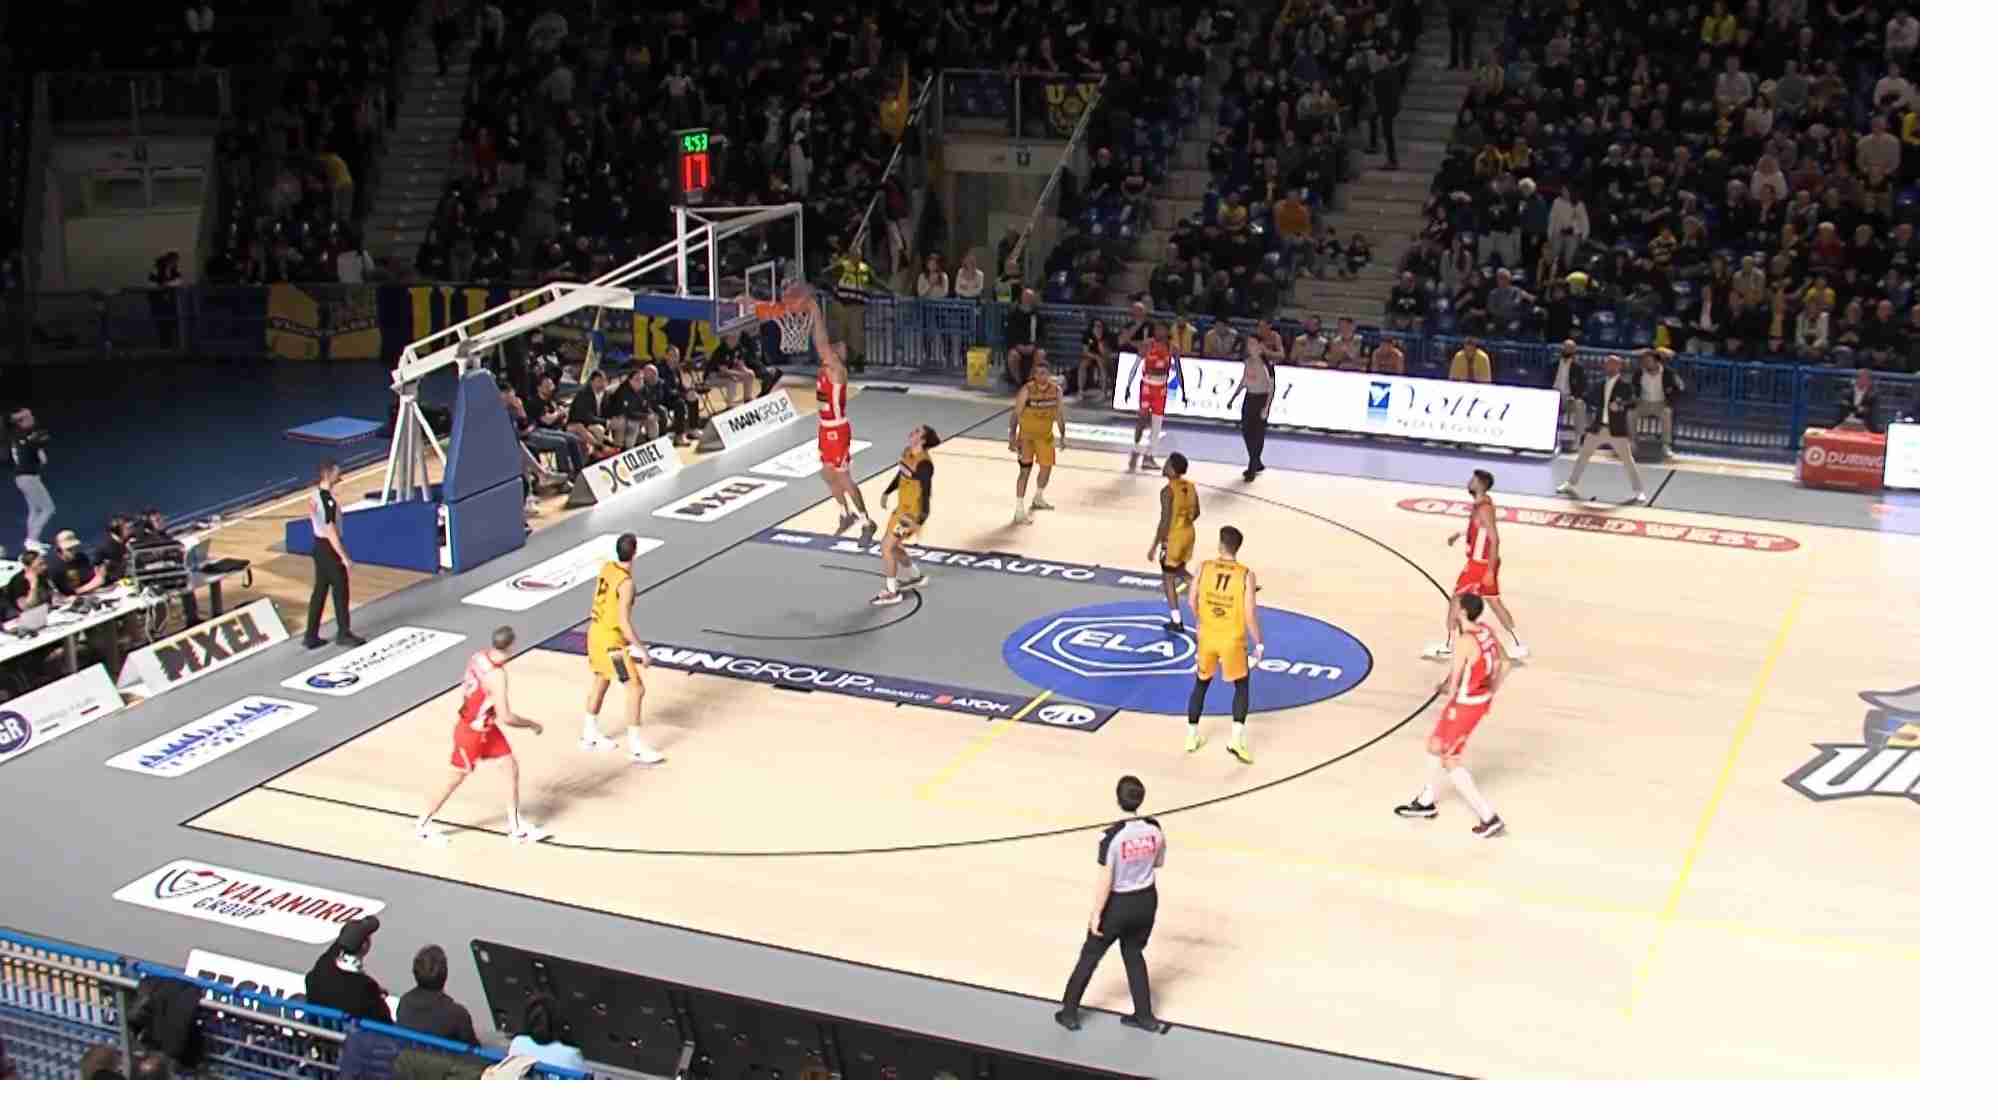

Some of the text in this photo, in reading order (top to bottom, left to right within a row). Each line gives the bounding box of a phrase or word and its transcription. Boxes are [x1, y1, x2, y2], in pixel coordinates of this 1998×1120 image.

[1644, 522, 1786, 549] WEST
[1069, 629, 1176, 658] ELA
[193, 896, 266, 920] GROUP
[221, 880, 365, 923] VALANDRO
